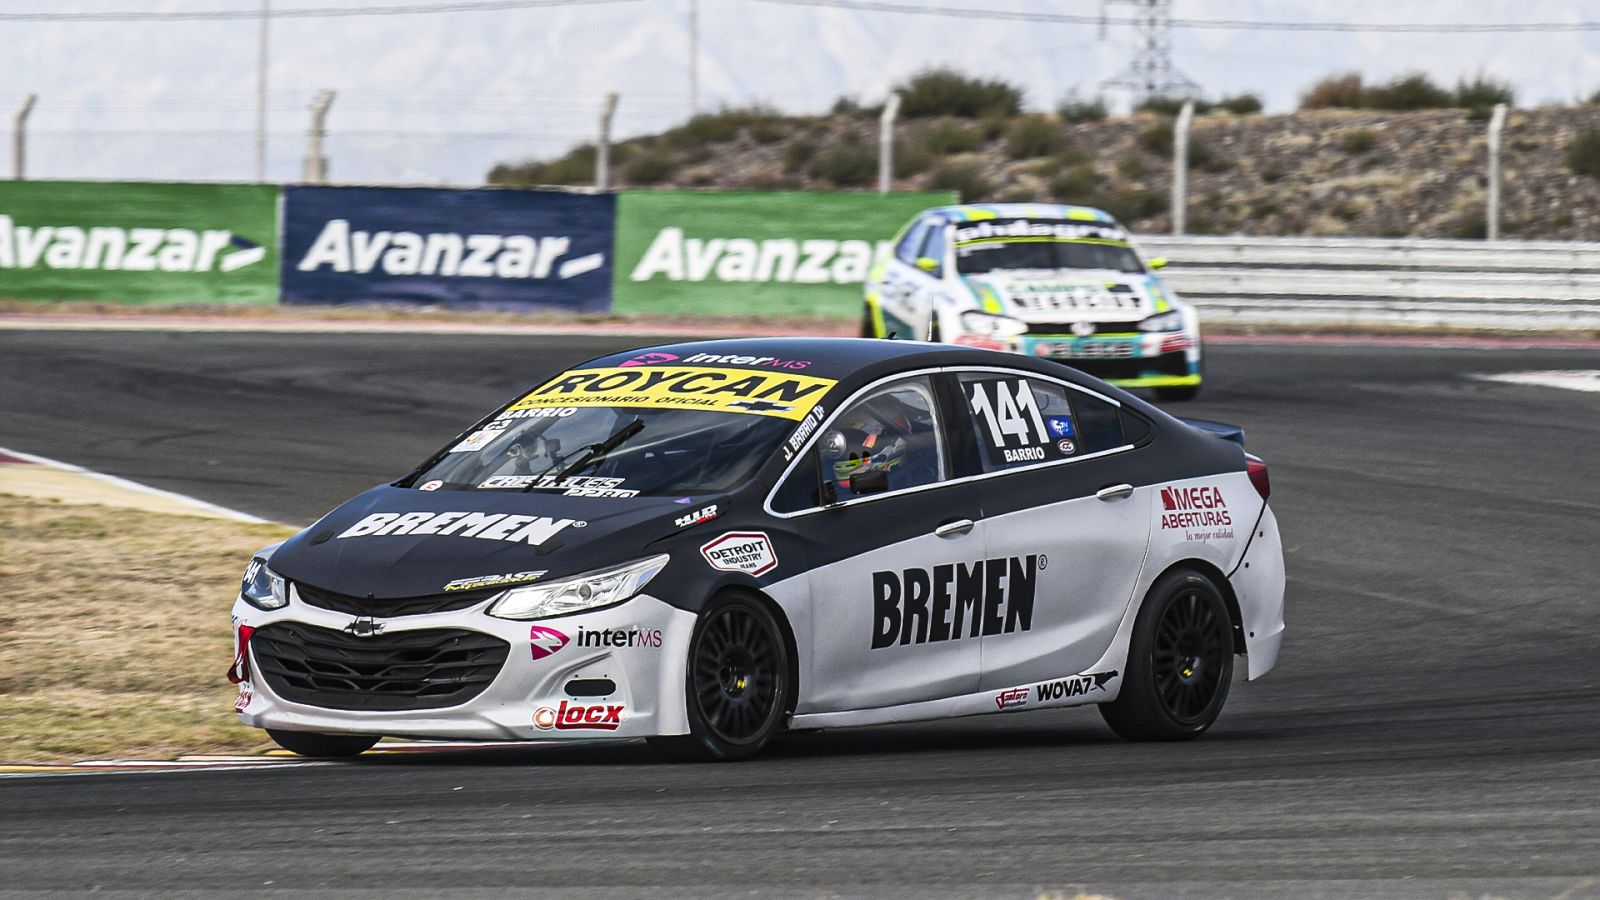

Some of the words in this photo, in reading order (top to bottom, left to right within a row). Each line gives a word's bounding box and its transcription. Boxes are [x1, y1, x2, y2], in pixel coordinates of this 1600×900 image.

[0, 214, 233, 272] vanzar
[298, 218, 571, 280] Avanzar
[683, 352, 813, 370] interMS
[536, 371, 829, 402] ROYCAN
[517, 395, 648, 407] CONCESIONARIO
[655, 396, 719, 408] OFICIAL
[494, 407, 578, 421] BARRIO
[970, 379, 1050, 448] 141
[788, 413, 819, 452] BARRIO
[1004, 446, 1045, 463] BARRIO
[1174, 486, 1226, 510] MEGA
[1161, 510, 1232, 530] ABERTURAS
[709, 541, 764, 560] DETROIT
[722, 553, 762, 565] INDUSTRY
[577, 625, 663, 648] interMS
[1036, 677, 1092, 702] WOVA7
